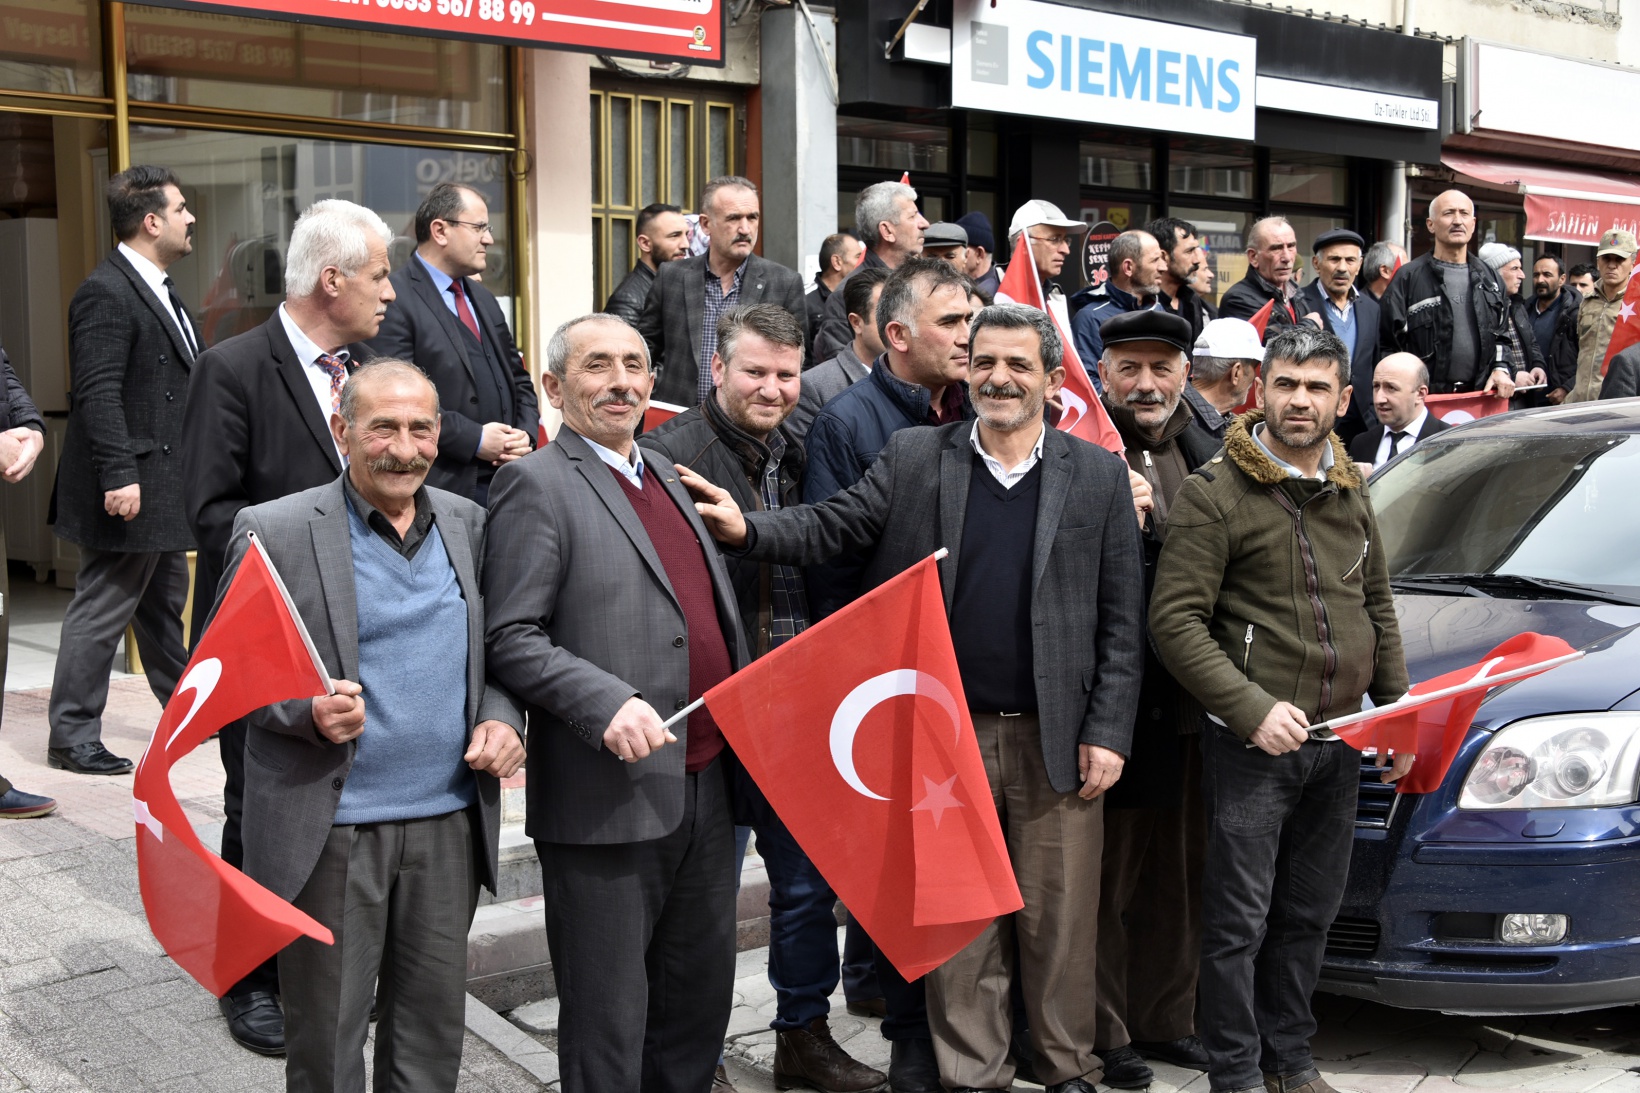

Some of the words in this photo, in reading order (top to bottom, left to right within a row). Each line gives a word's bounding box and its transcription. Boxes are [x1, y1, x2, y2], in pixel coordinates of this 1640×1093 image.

[478, 0, 505, 22] 88
[508, 0, 536, 26] 99
[3, 16, 79, 48] Veysel
[1026, 29, 1241, 113] SIEMENS
[1091, 264, 1108, 286] 36
